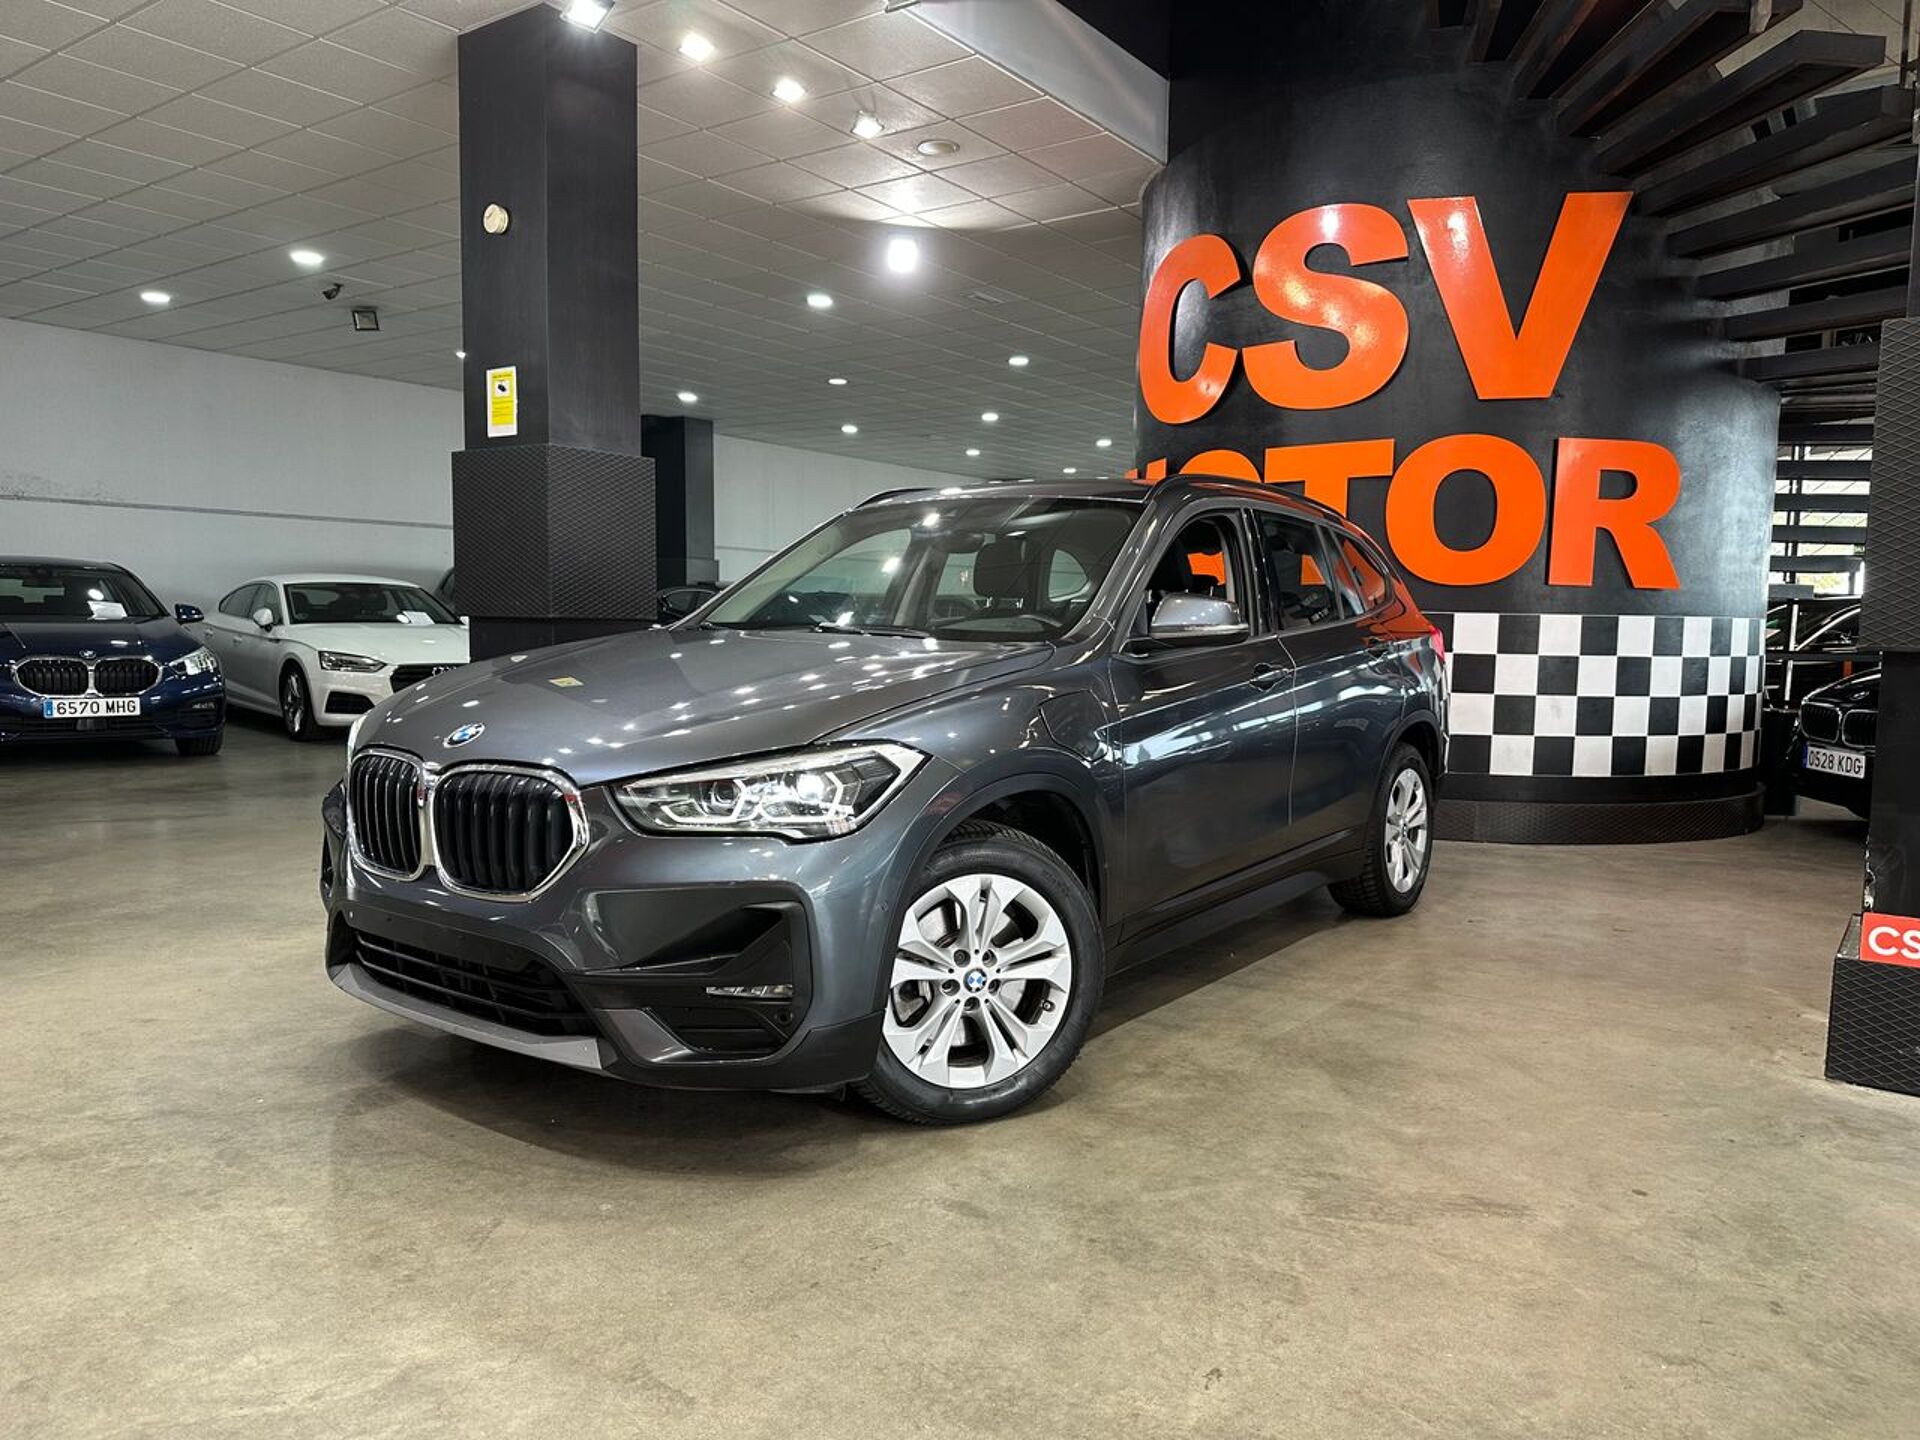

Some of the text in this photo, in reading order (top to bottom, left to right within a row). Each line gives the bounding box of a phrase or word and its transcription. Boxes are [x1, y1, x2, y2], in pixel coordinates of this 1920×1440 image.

[1138, 190, 1634, 425] CSV
[1124, 433, 1682, 591] TOR
[56, 700, 136, 715] 6570 MHG
[1808, 750, 1864, 775] 0528 KDG
